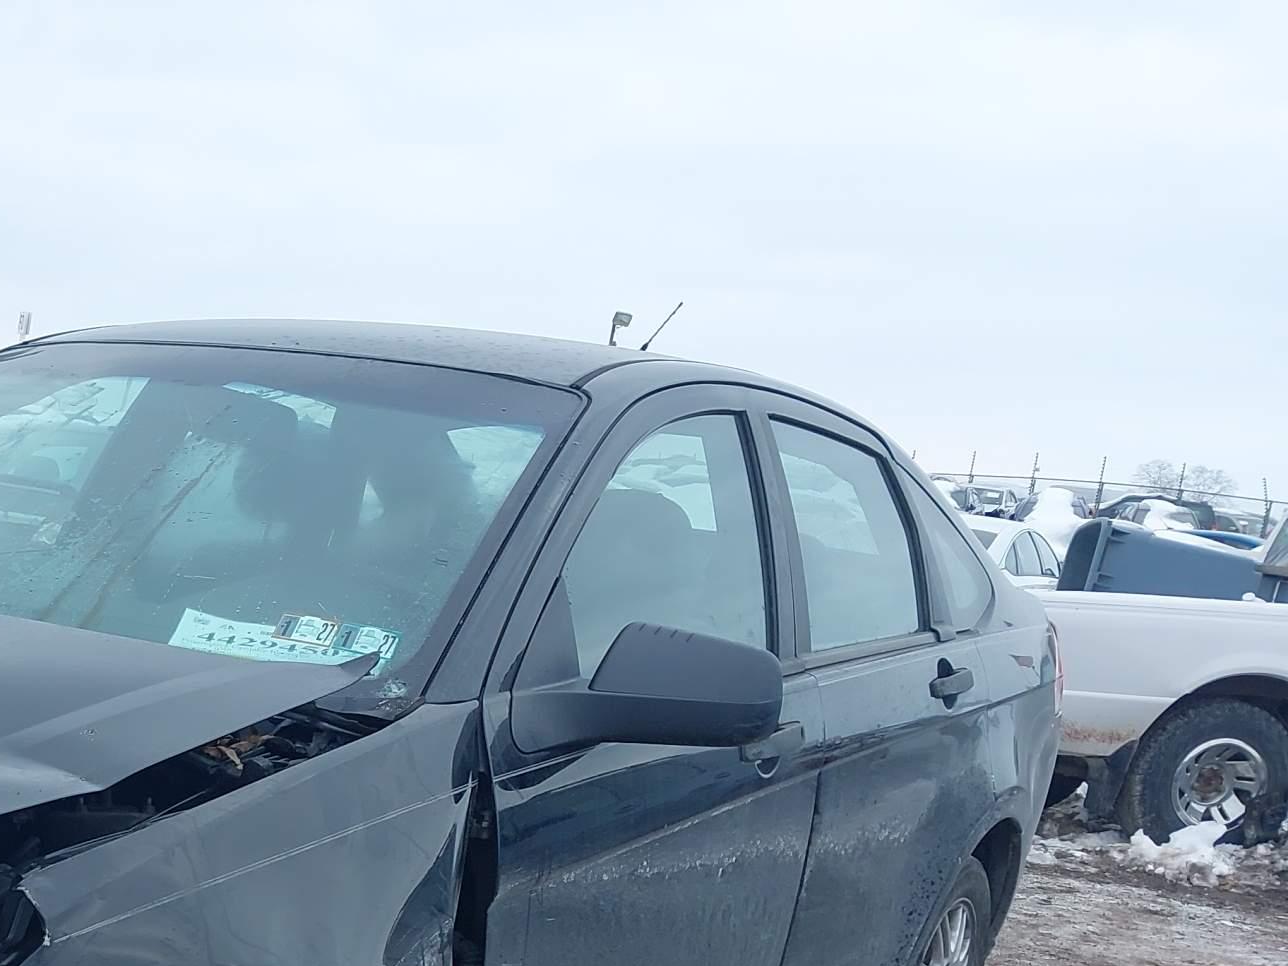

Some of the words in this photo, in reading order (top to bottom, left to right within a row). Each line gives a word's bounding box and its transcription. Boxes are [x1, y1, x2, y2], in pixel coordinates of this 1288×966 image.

[196, 631, 352, 656] 4429450
[315, 621, 337, 644] 27
[378, 634, 397, 656] 27
